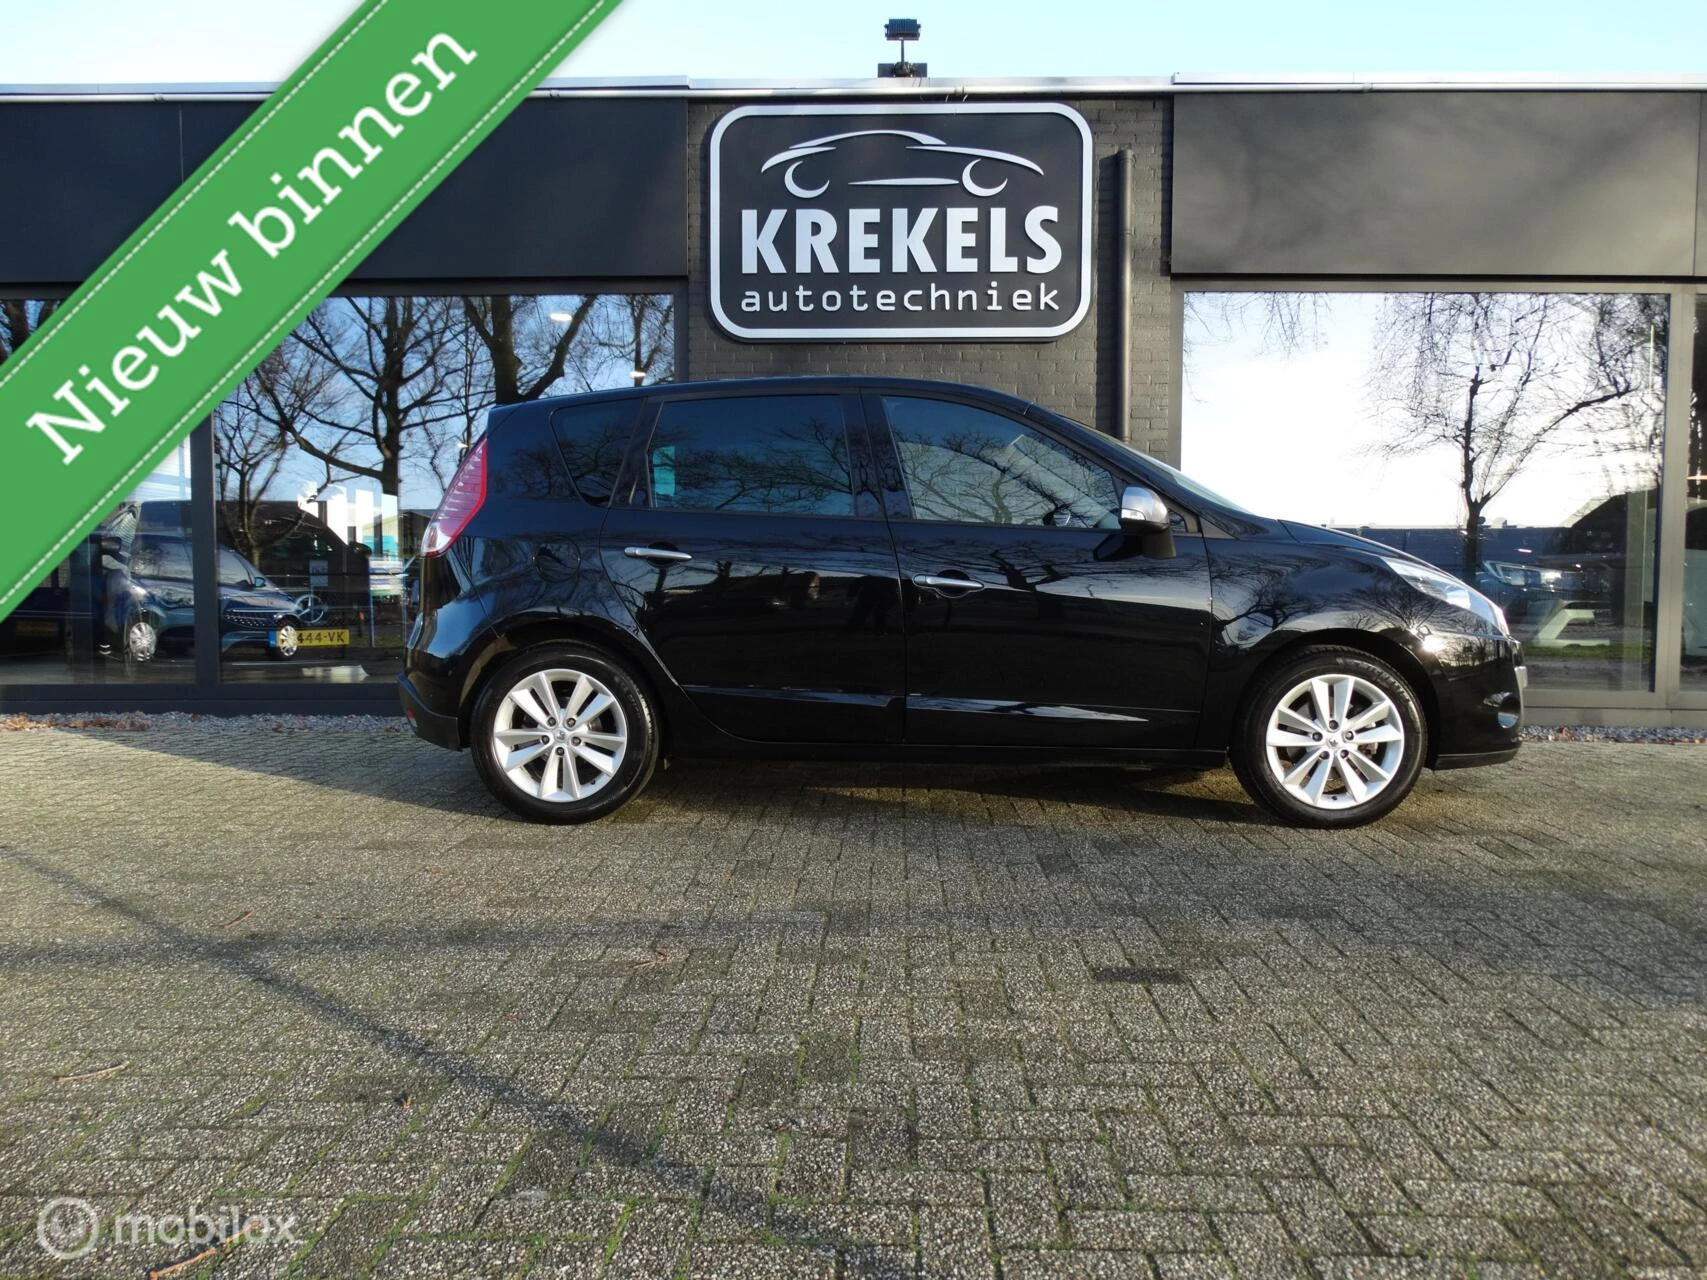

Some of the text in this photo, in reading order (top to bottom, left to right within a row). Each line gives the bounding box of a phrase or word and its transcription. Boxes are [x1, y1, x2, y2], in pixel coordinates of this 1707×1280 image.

[741, 204, 1063, 274] KREKELS
[741, 280, 1060, 312] autotechniek
[286, 631, 345, 644] 444-VK
